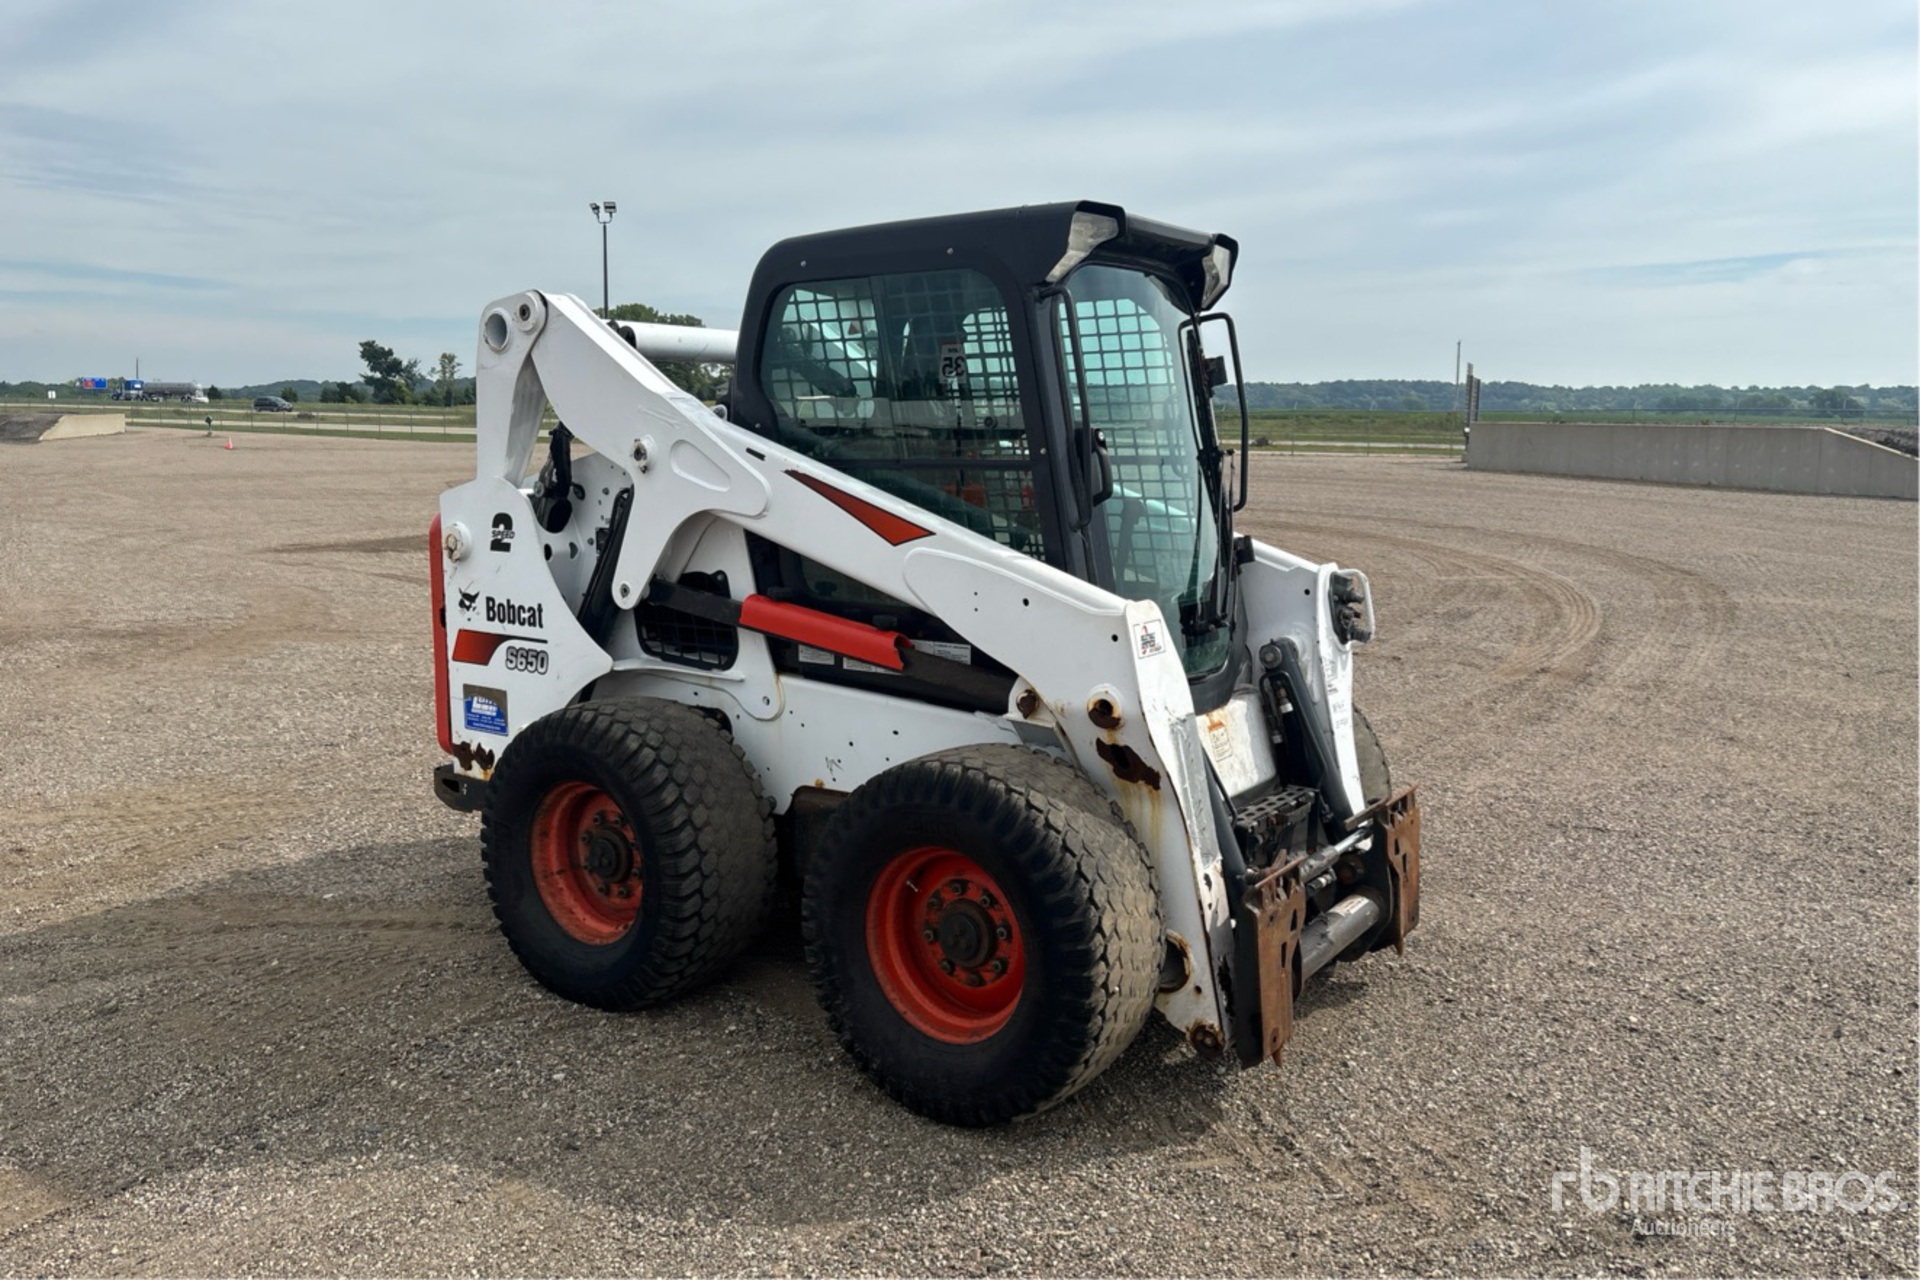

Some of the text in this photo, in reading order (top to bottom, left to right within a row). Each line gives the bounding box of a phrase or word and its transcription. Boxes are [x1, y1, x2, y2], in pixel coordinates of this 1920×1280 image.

[490, 512, 514, 553] 2
[491, 529, 516, 540] SPEED
[485, 596, 544, 629] Bobcat
[505, 645, 549, 675] S650
